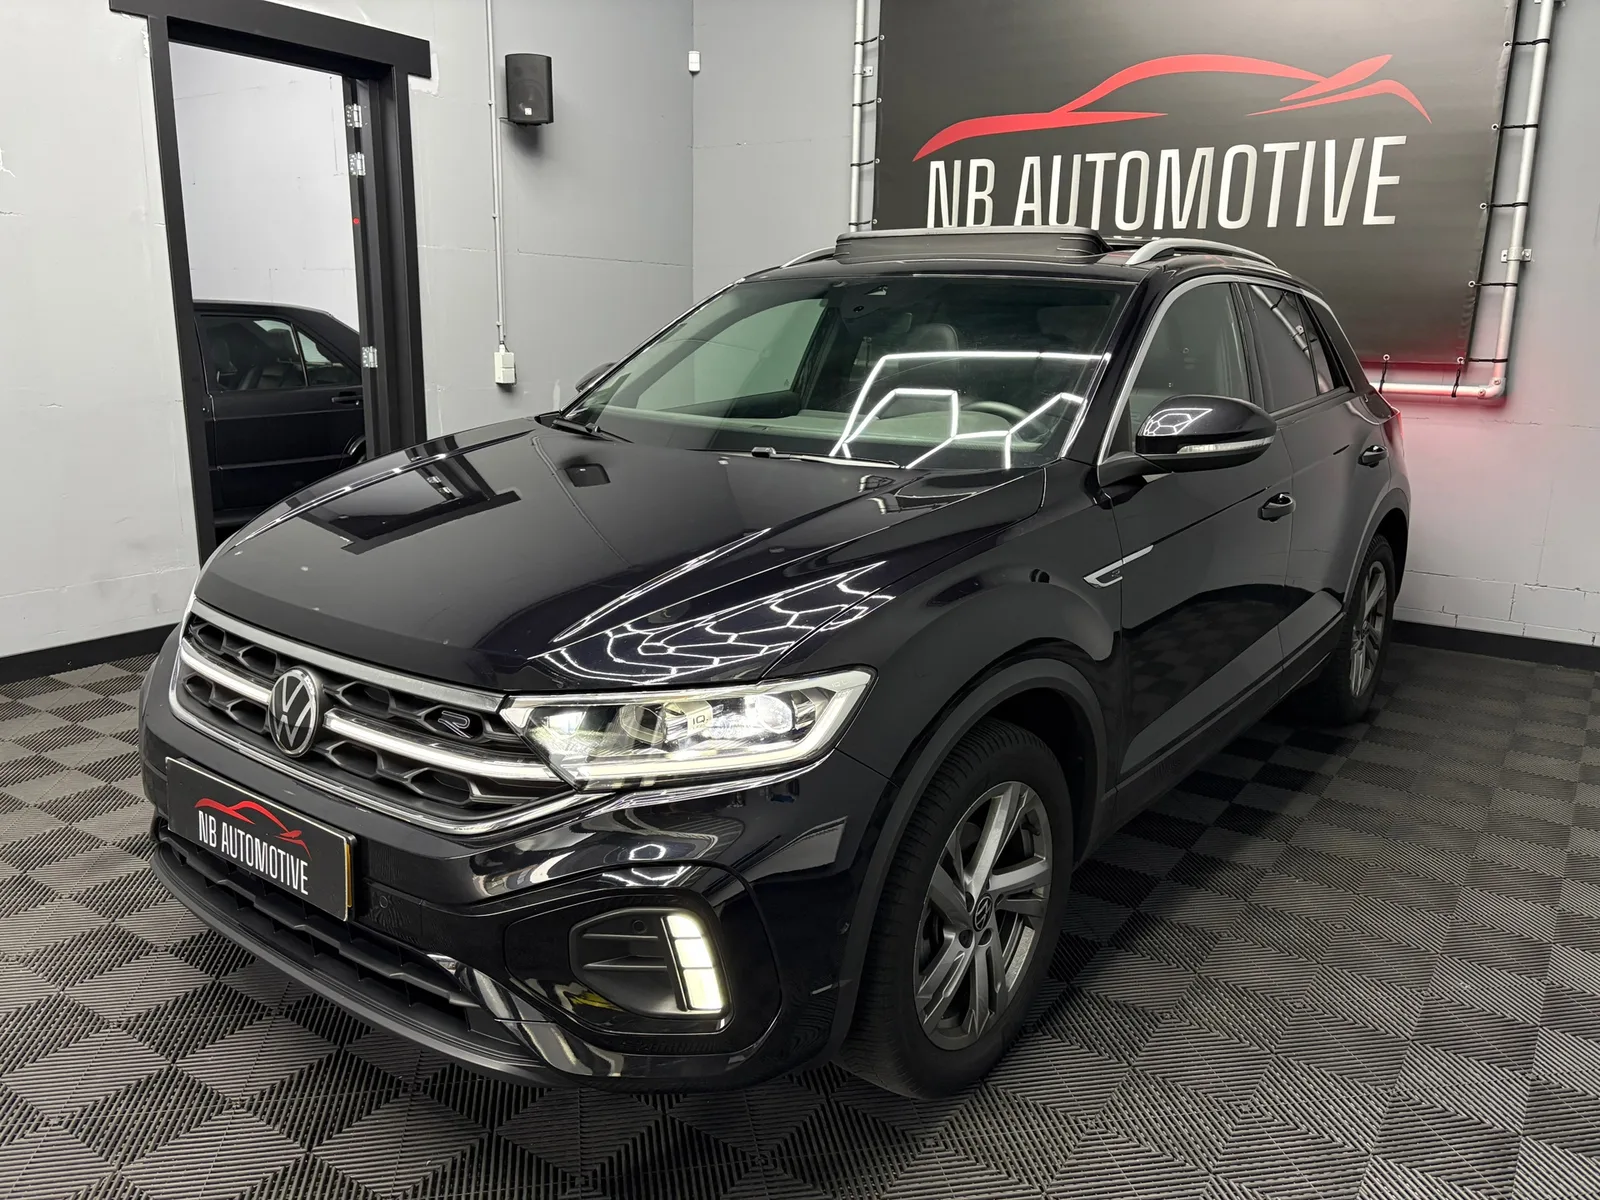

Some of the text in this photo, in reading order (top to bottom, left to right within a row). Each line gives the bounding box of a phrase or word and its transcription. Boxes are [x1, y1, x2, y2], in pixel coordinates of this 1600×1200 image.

[927, 135, 1407, 231] NB AUTOMOTIVE
[198, 810, 309, 896] NB AUTOMOTIVE
